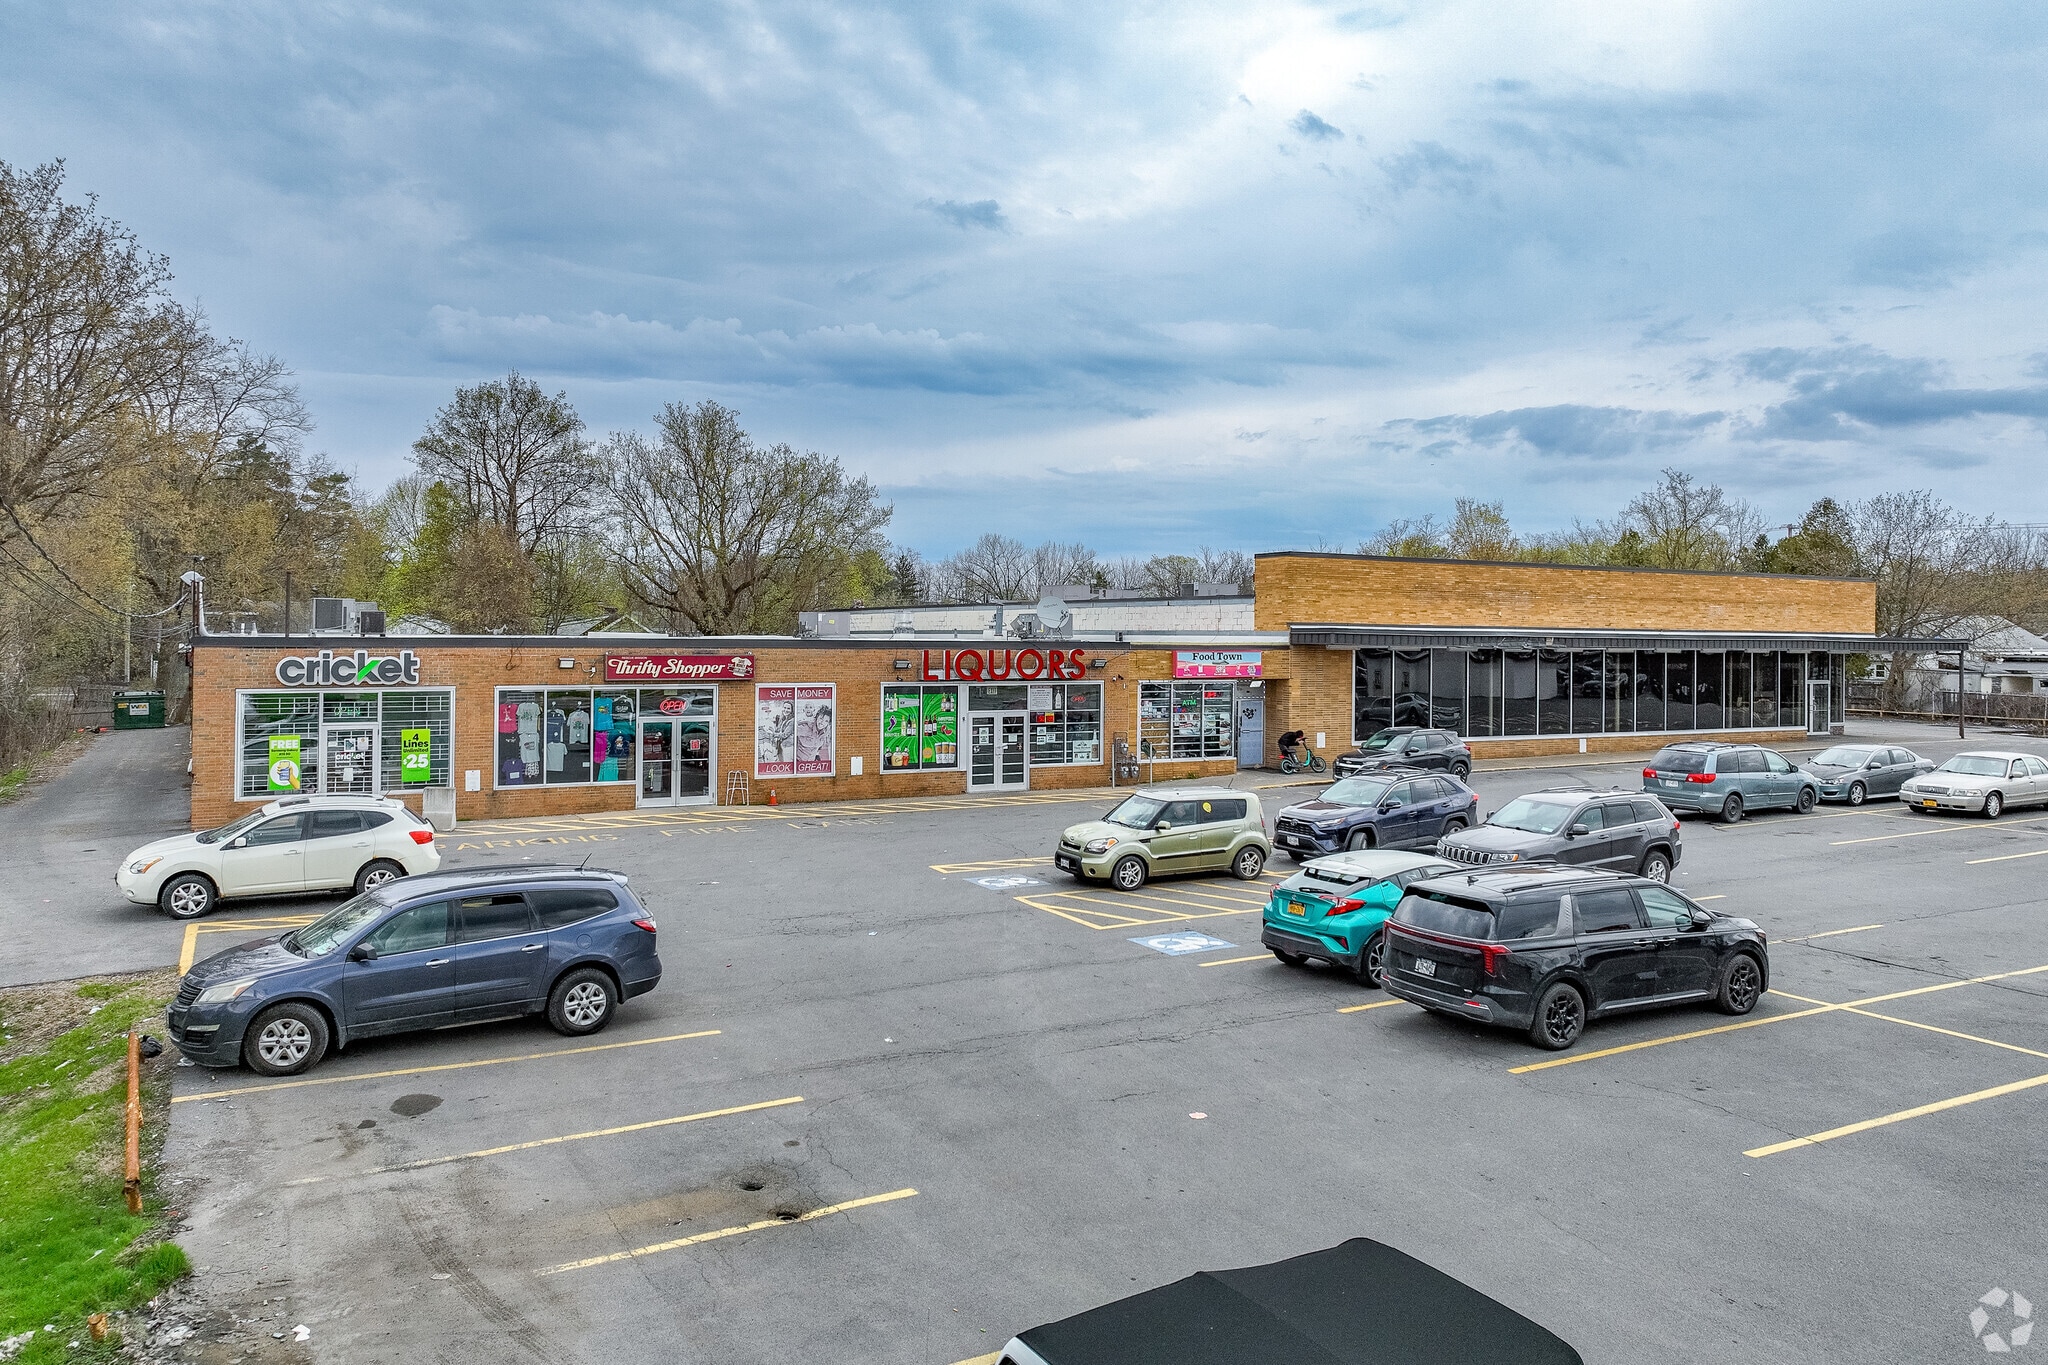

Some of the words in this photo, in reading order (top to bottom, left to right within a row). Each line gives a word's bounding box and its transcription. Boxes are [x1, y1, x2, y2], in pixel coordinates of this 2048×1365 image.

[1192, 651, 1215, 661] Food
[1216, 651, 1243, 661] Town
[277, 651, 419, 684] cricket
[608, 658, 662, 678] Thrifty
[662, 658, 726, 678] Shopper
[922, 649, 1086, 682] LIQUORS
[769, 689, 793, 698] SAVE
[797, 688, 829, 698] MONEY
[663, 698, 687, 711] OPEN
[412, 733, 420, 741] 4
[271, 739, 300, 749] FREE
[403, 740, 429, 748] Lines
[335, 752, 365, 760] cricket
[402, 753, 429, 769] $25
[766, 764, 792, 773] LOOK
[798, 762, 829, 772] GREAT!
[660, 825, 757, 837] FIRE
